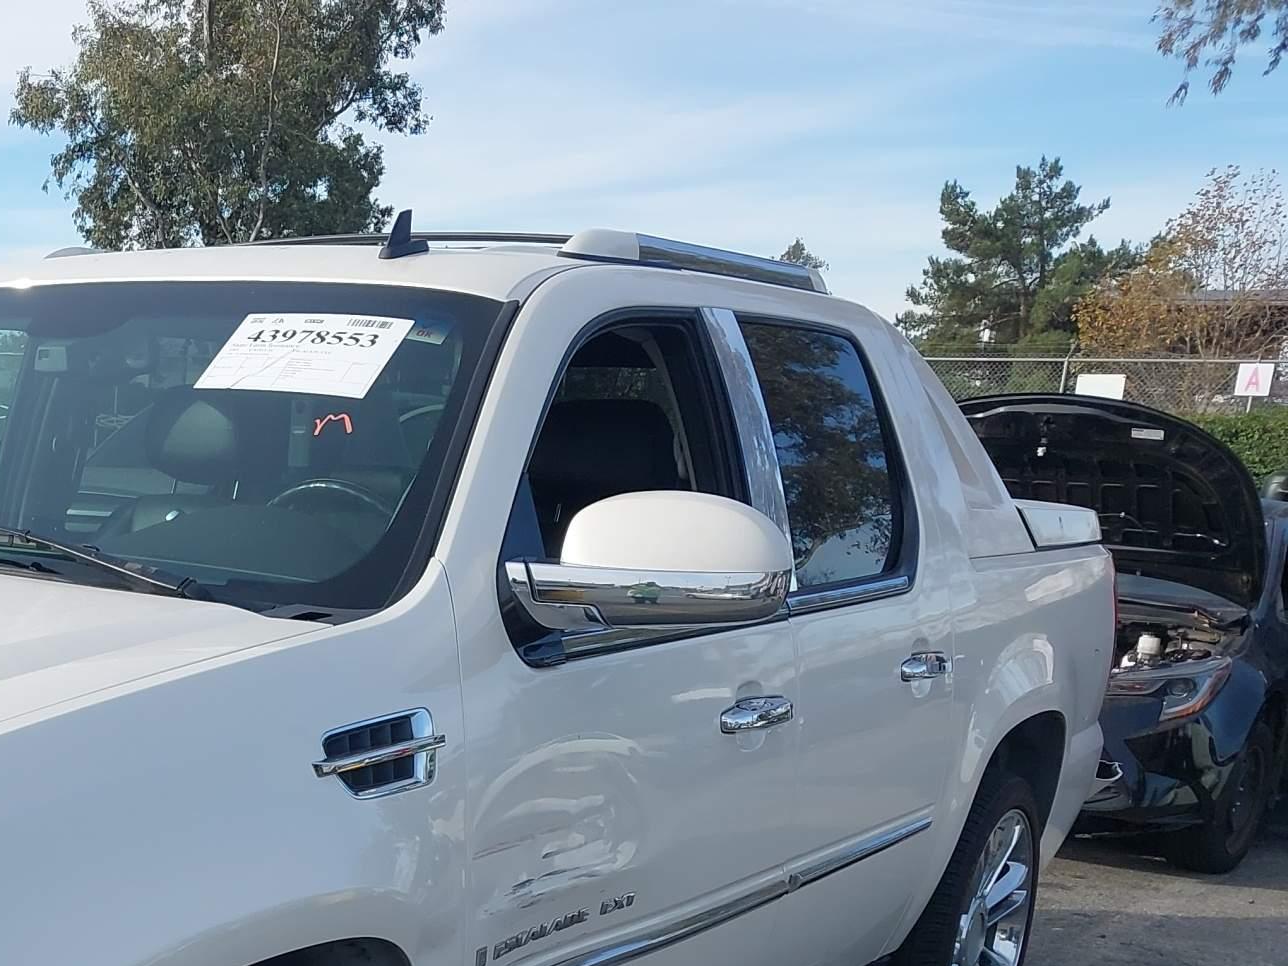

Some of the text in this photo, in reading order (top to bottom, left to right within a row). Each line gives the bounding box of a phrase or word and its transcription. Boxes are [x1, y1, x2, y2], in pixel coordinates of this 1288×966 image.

[247, 329, 379, 348] 43978553
[1244, 367, 1260, 392] A
[600, 891, 637, 916] EXT
